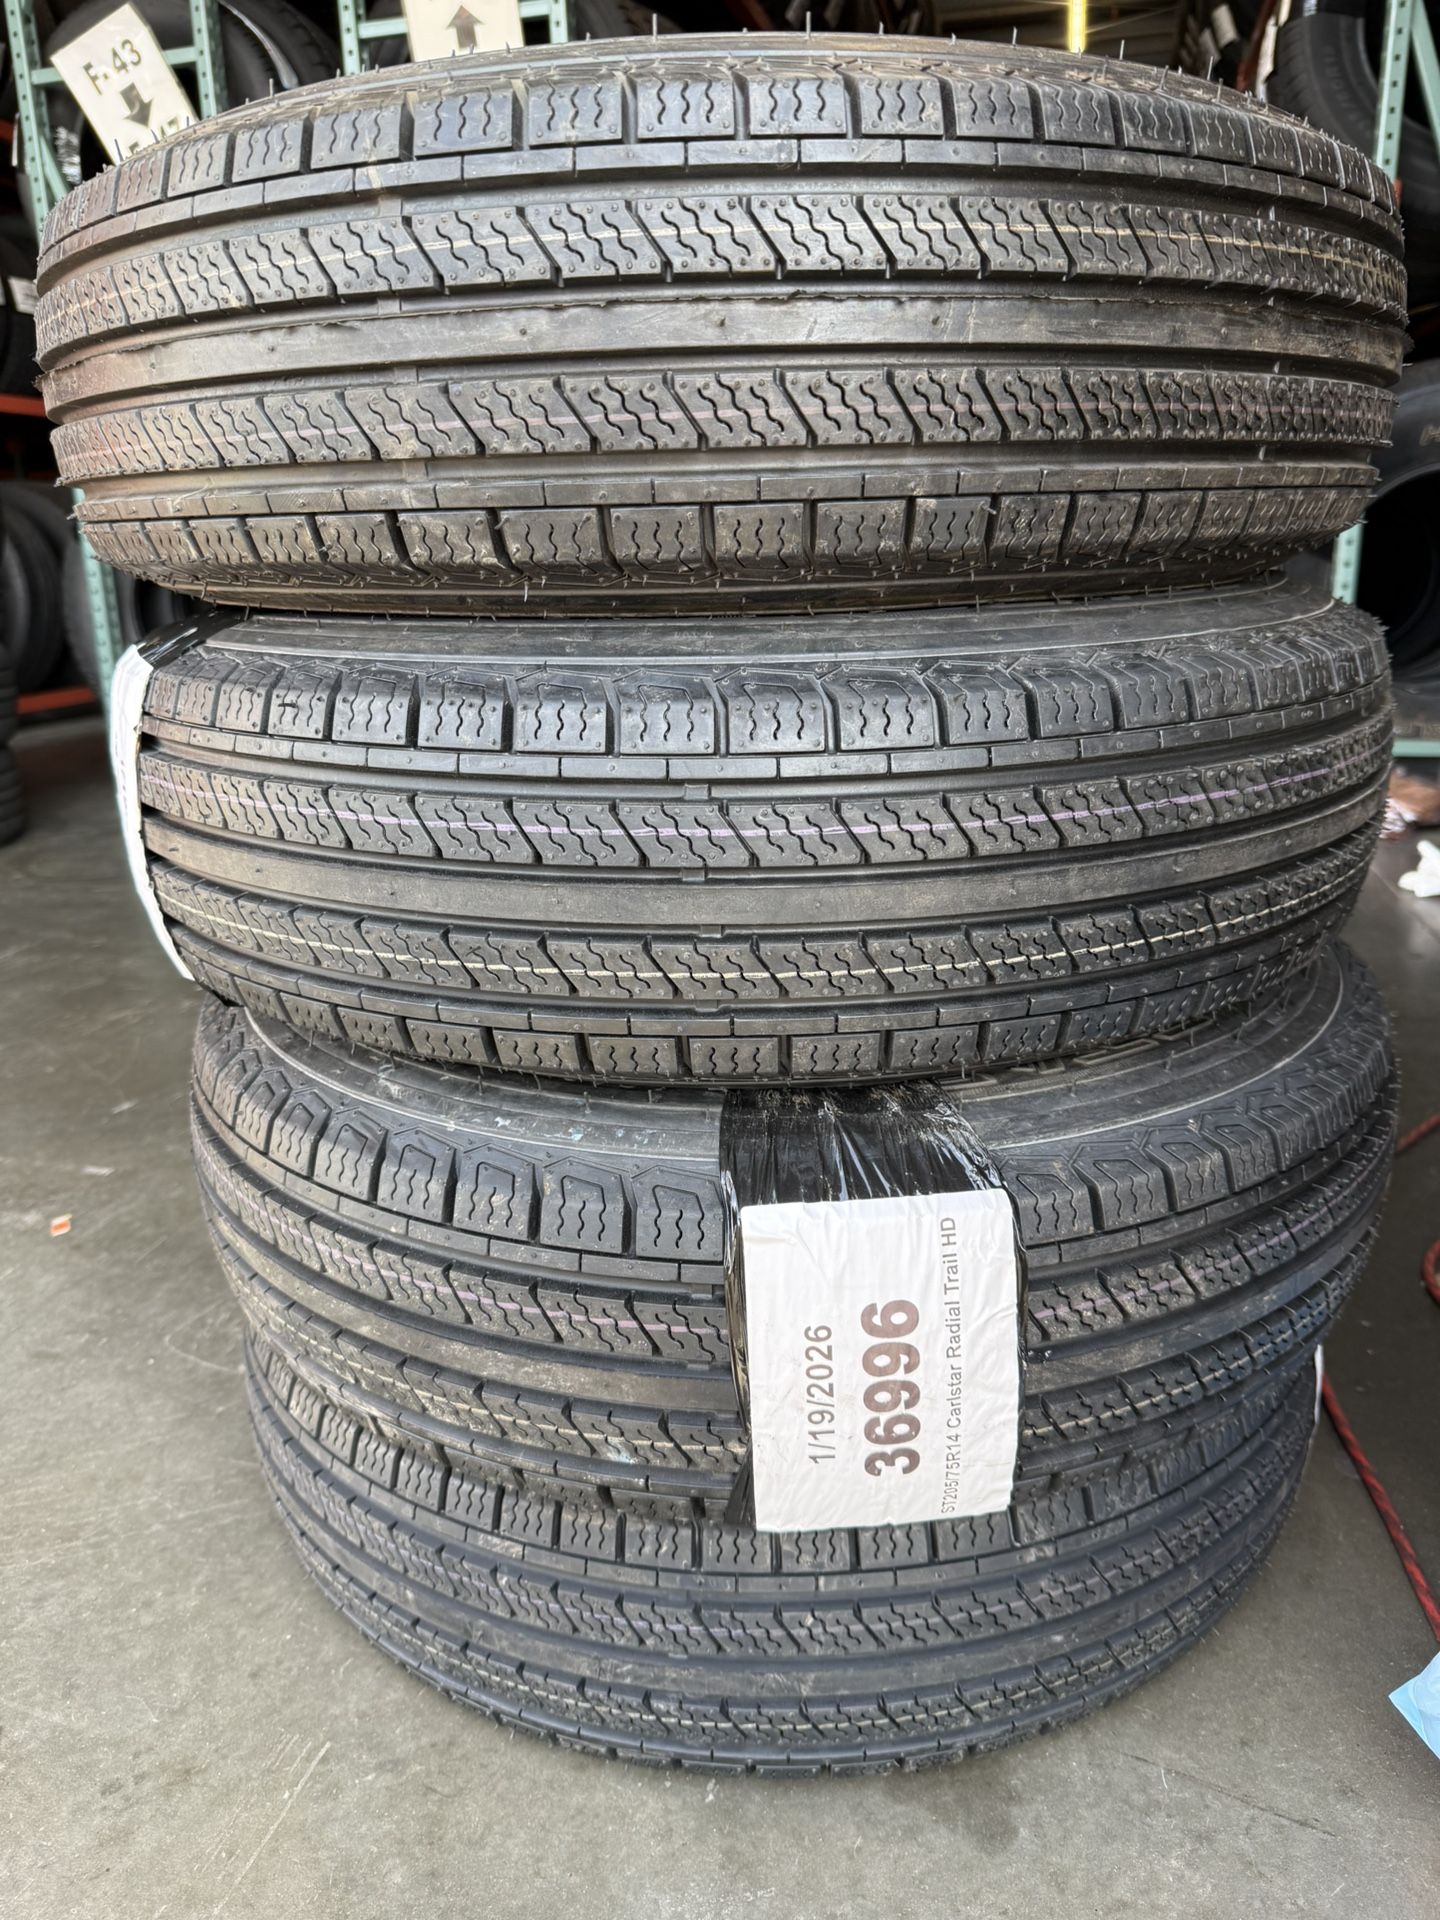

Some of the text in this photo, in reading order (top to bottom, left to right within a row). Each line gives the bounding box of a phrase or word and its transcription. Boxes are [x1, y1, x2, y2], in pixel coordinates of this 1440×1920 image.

[804, 1325, 836, 1464] 1/19/2026
[860, 1299, 921, 1477] 36996
[940, 1217, 962, 1514] ST205/75R14 Carlstar Radial Trail HD
